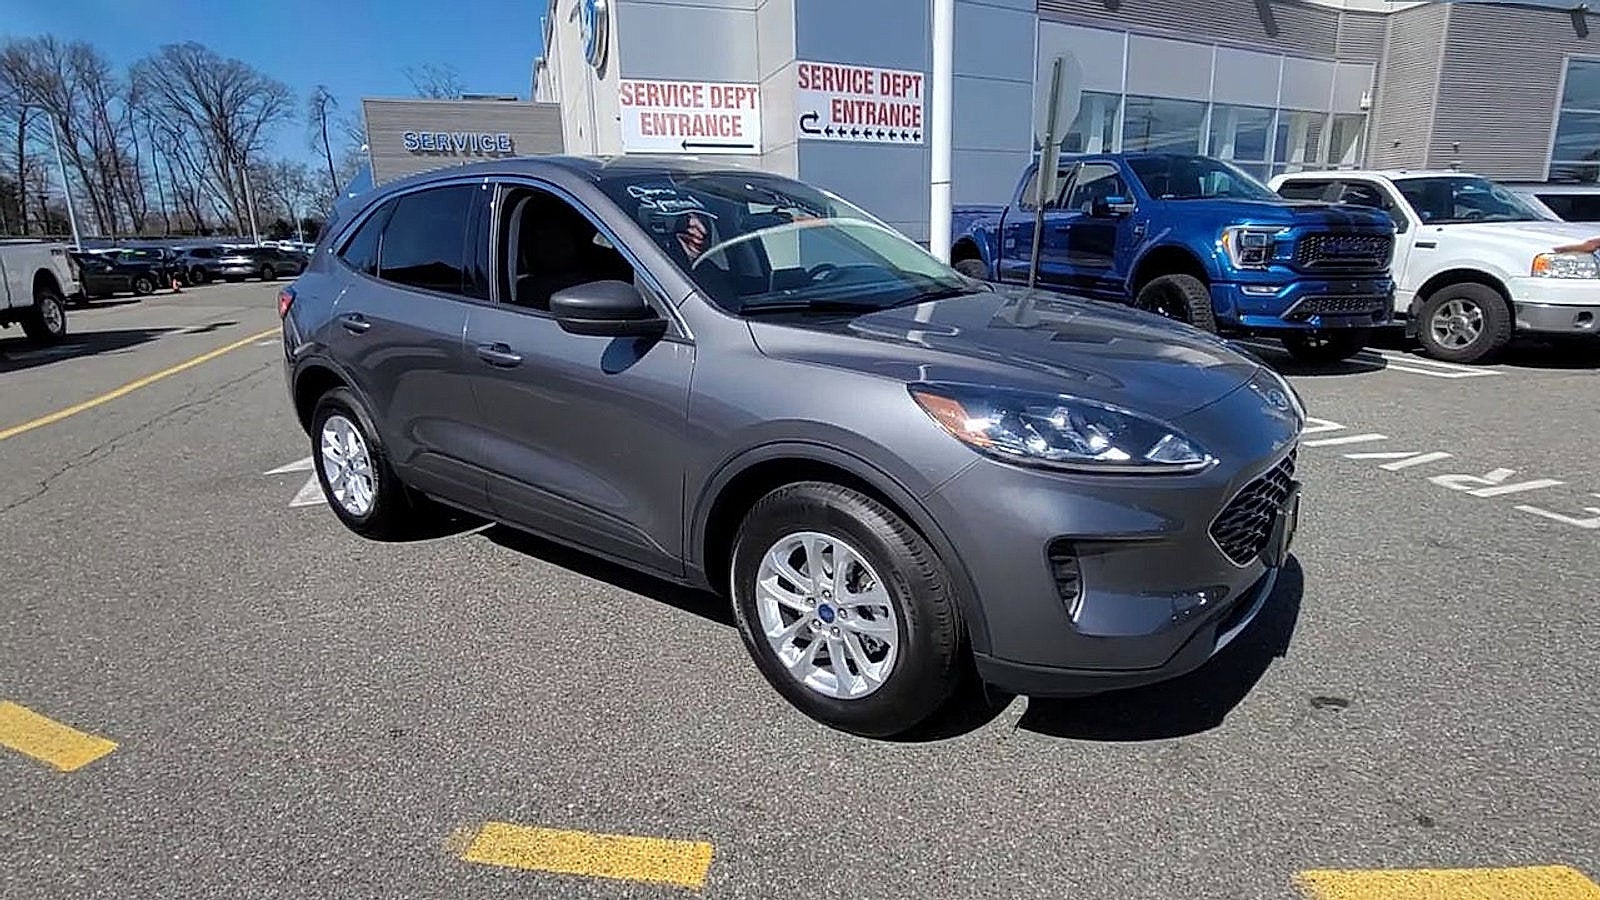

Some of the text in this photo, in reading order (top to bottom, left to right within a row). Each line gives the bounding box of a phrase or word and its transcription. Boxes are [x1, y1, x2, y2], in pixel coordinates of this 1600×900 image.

[798, 63, 922, 99] SERVICE DEPT
[620, 82, 758, 110] SERVICE DEPT
[640, 112, 743, 138] ENTRANCE
[831, 99, 922, 128] ENTRANCE
[403, 130, 512, 152] SERVICE
